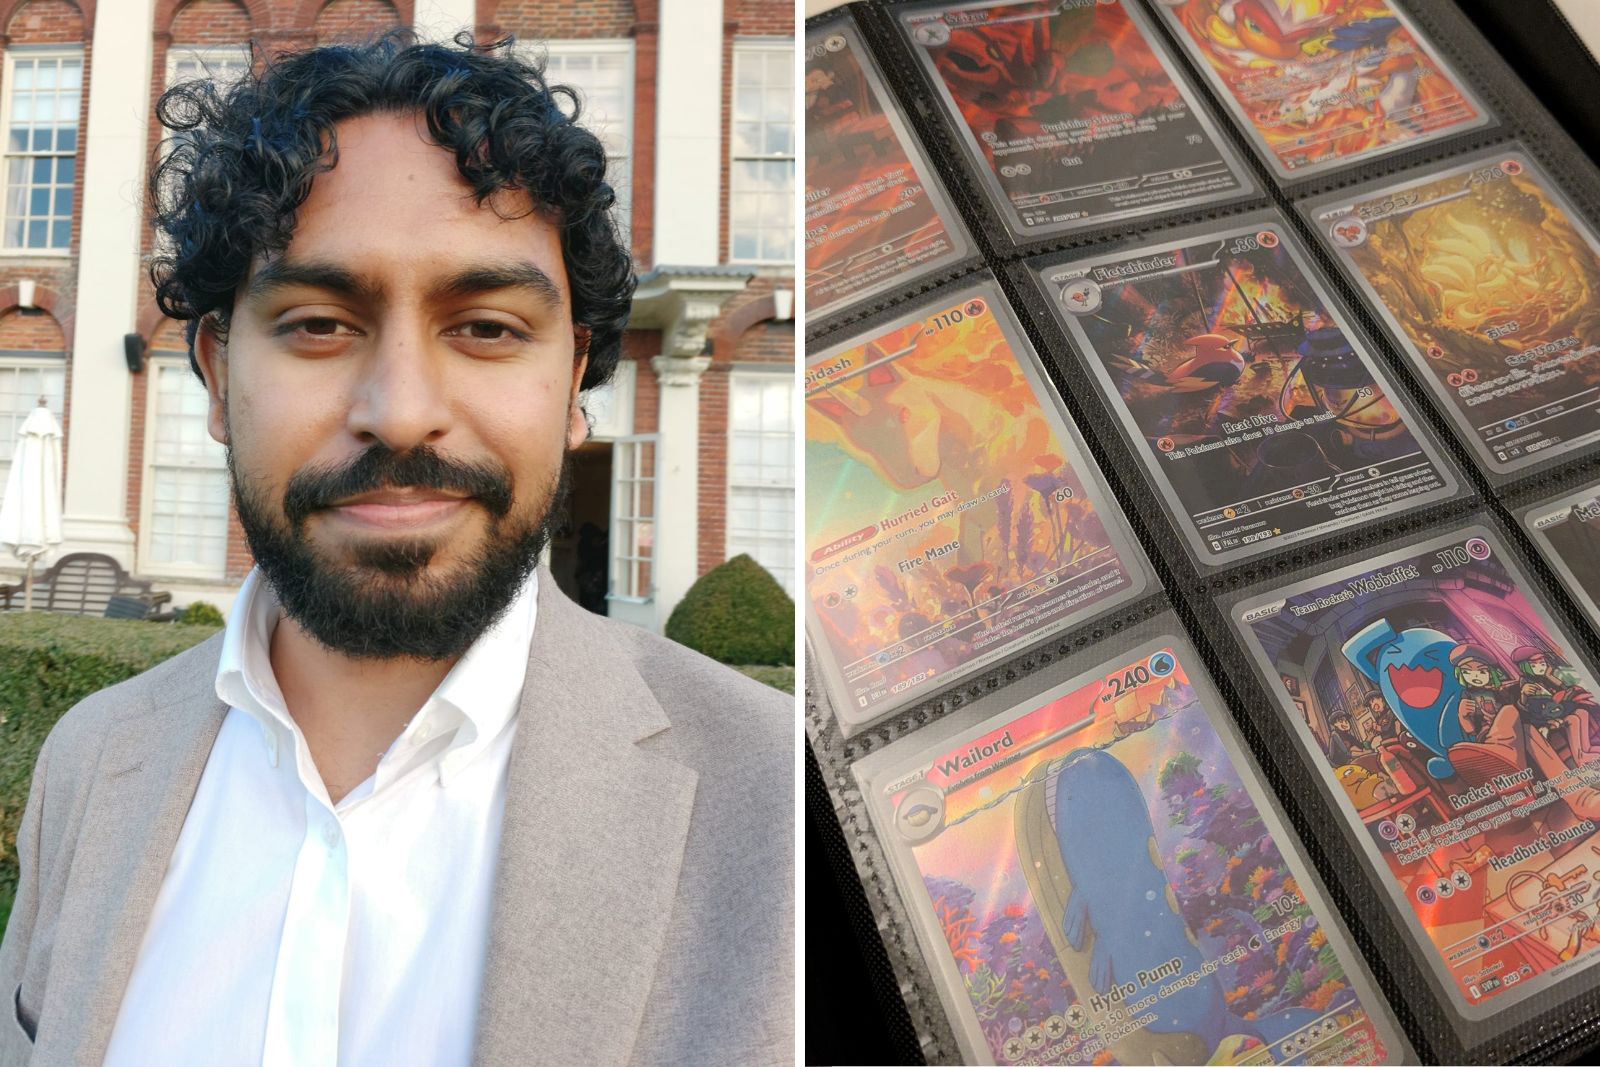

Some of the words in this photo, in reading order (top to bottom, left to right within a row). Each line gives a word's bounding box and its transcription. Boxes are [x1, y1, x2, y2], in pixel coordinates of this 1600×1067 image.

[1234, 237, 1261, 251] 80
[1094, 256, 1175, 279] Fletchinder
[934, 310, 963, 330] 110
[1355, 387, 1374, 398] 50
[1222, 418, 1253, 433] Heat
[1250, 412, 1278, 426] Dive
[1165, 450, 1186, 460] This
[1185, 440, 1224, 455] Pokémon
[1223, 435, 1242, 445] also
[1240, 430, 1262, 441] does
[1272, 419, 1305, 434] damage
[1312, 410, 1336, 422] itself.
[1053, 486, 1074, 502] 60
[880, 504, 927, 531] Hurried
[930, 489, 958, 508] Gait
[1537, 512, 1563, 527] BASIC
[815, 560, 840, 576] Once
[841, 546, 871, 565] during
[872, 537, 893, 551] your
[918, 517, 936, 530] you
[936, 509, 954, 522] may
[957, 498, 978, 512] draw
[986, 484, 1009, 499] card.
[823, 532, 864, 555] Ability
[897, 554, 924, 572] Fire
[925, 538, 959, 560] Mane
[1437, 548, 1471, 568] 110
[1291, 601, 1318, 616] Team
[1315, 589, 1355, 608] Rocket's
[1350, 565, 1419, 595] Wobbuffet
[1246, 607, 1278, 620] BASIC
[1106, 666, 1152, 697] 240
[1101, 692, 1113, 703] HP
[938, 735, 1013, 778] Wailord
[887, 776, 918, 794] STAGE
[975, 767, 992, 780] from
[1450, 784, 1494, 808] Rocket
[1493, 766, 1535, 790] Mirror
[1390, 836, 1418, 852] Move
[1416, 830, 1430, 841] all
[1430, 817, 1466, 838] damage
[1464, 801, 1503, 821] counters
[1501, 791, 1526, 806] from
[1531, 782, 1545, 793] of
[1542, 776, 1565, 790] your
[1564, 760, 1599, 779] Benched
[1436, 825, 1478, 847] Pokémon
[1477, 820, 1490, 831] to
[1489, 812, 1513, 827] your
[1511, 792, 1559, 817] opponent's
[1556, 780, 1584, 796] Active
[1489, 838, 1549, 870] Headbutt
[1548, 818, 1594, 845] Bounce
[1272, 893, 1303, 916] 10+
[1448, 945, 1477, 961] weakness
[1040, 1036, 1076, 1060] attack
[1079, 1021, 1107, 1040] does
[1108, 1011, 1124, 1024] 50
[1126, 996, 1157, 1014] more
[1158, 972, 1202, 999] damage
[1200, 960, 1220, 975] for
[1220, 946, 1247, 964] each
[1262, 918, 1303, 942] Energy
[1090, 981, 1139, 1014] Hydro
[1138, 958, 1185, 990] Pump
[1501, 971, 1520, 984] 203
[1065, 1050, 1082, 1064] to
[1082, 1037, 1103, 1054] this
[1104, 1013, 1158, 1043] Pokémon.
